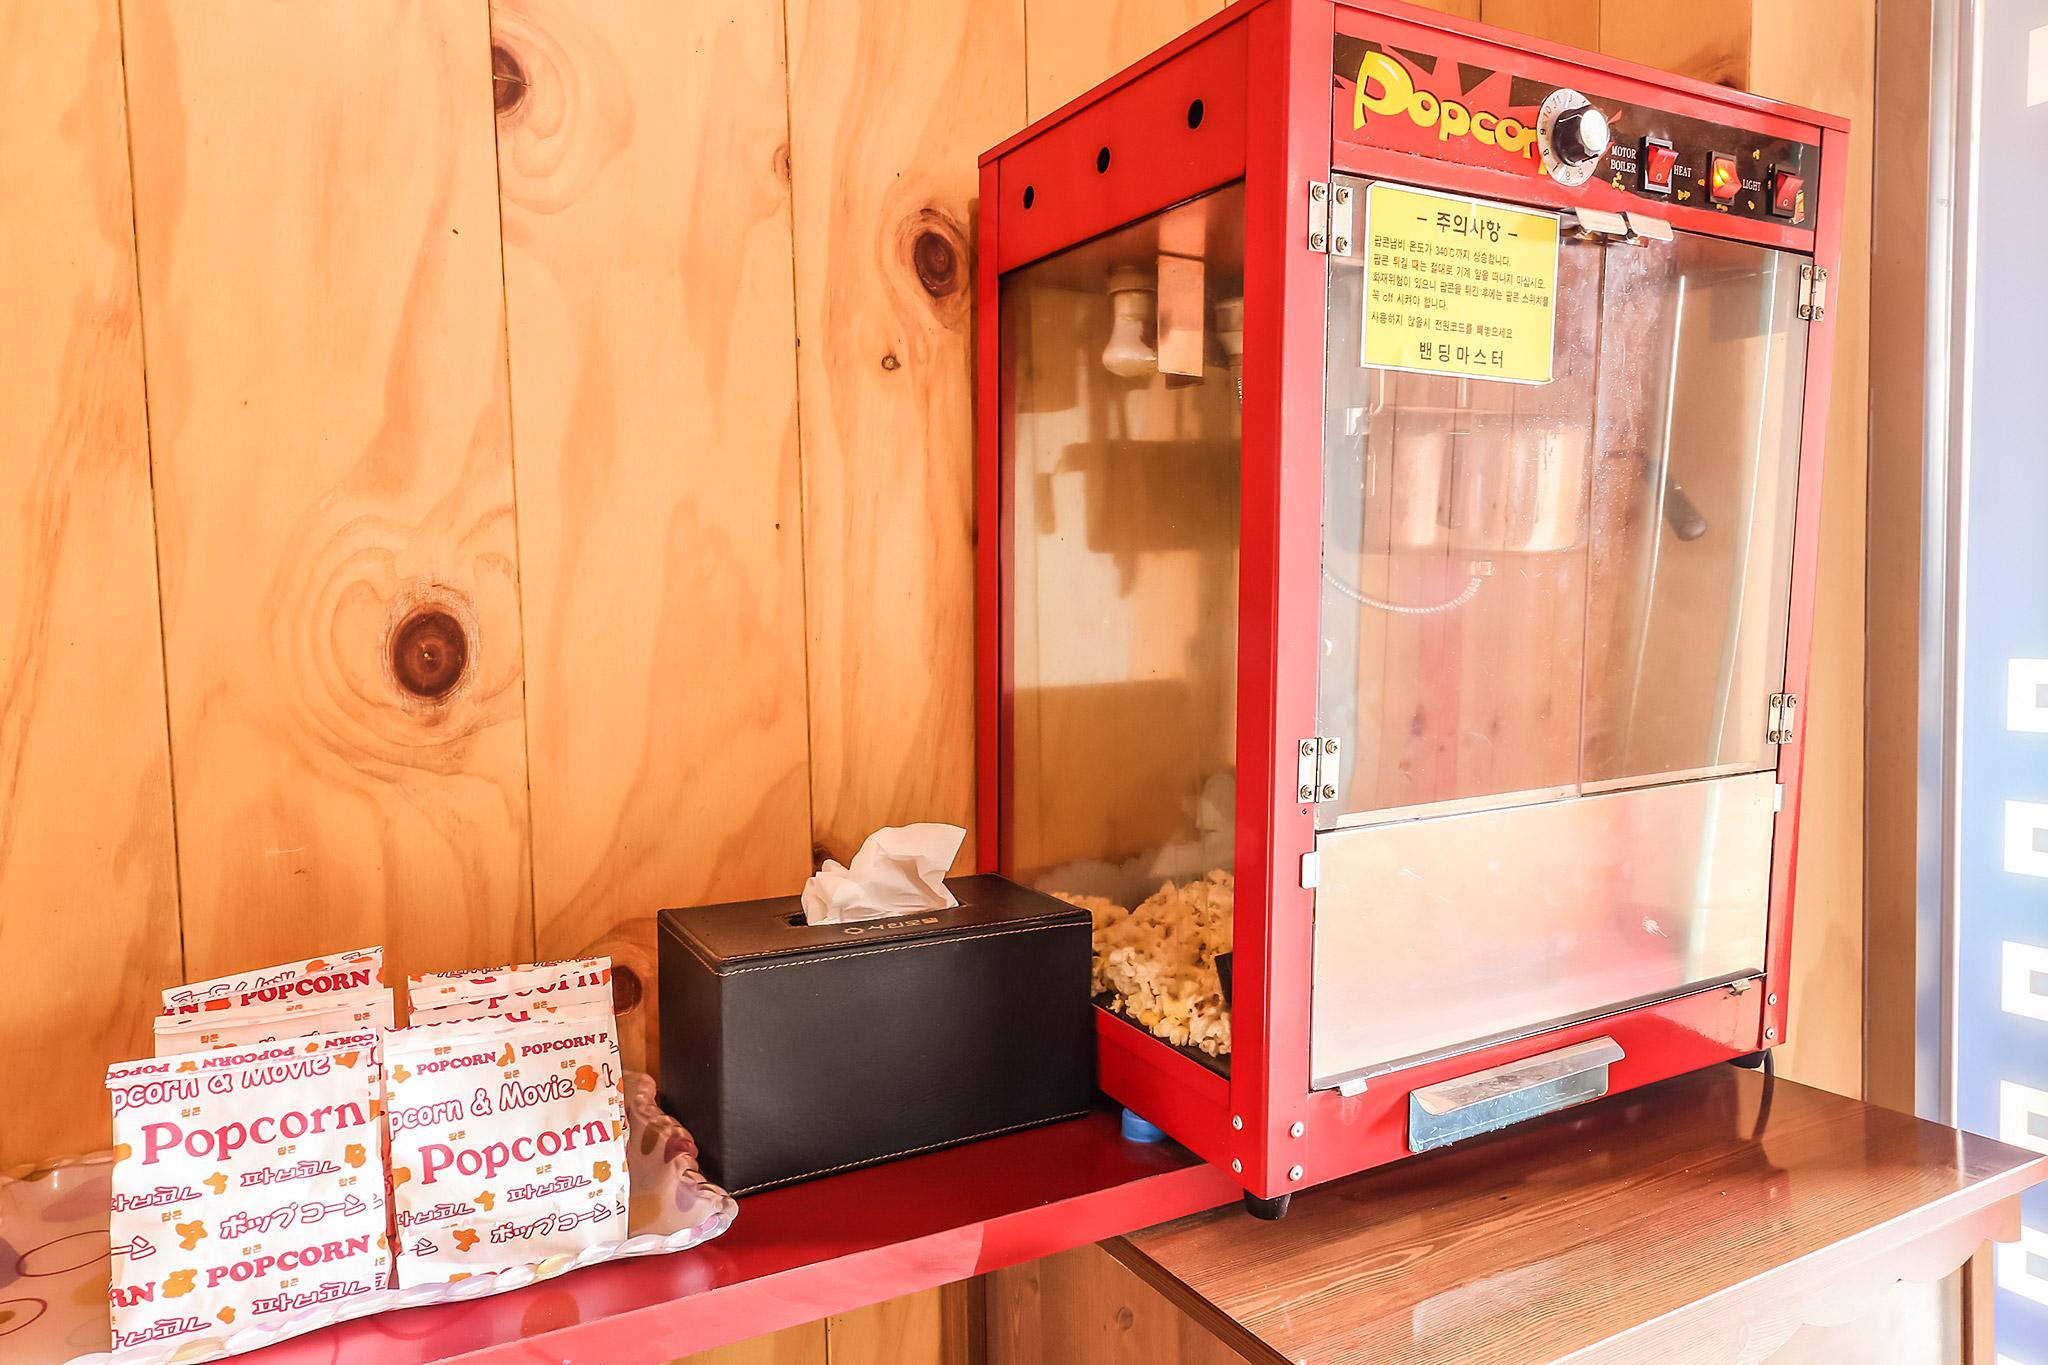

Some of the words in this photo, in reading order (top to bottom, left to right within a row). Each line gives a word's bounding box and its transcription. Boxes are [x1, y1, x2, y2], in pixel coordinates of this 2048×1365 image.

[1354, 50, 1548, 175] Popcor
[1610, 159, 1637, 174] BOILER
[1611, 145, 1637, 160] MOTOR
[1673, 164, 1692, 178] HEAT
[1742, 178, 1762, 192] LIGHT
[1437, 211, 1501, 243] 주의사항
[1374, 234, 1405, 252] 팝콘냄비
[1409, 240, 1432, 256] 온도가
[1473, 251, 1511, 268] 상승합니다.
[1373, 253, 1389, 267] 팝콘
[1393, 256, 1408, 270] 튀길
[1411, 259, 1427, 273] 때는
[1431, 262, 1453, 276] 절대로
[1456, 265, 1471, 279] 기계
[1474, 268, 1489, 282] 앞을
[1492, 271, 1513, 286] 떠나지
[1372, 271, 1411, 288] 화재위험이
[1414, 277, 1436, 292] 있으니
[1440, 281, 1462, 296] 팝콘을
[1465, 284, 1479, 298] 튀긴
[1482, 287, 1503, 301] 후에는
[1506, 290, 1519, 303] 팝콘
[1522, 294, 1549, 308] 스위치를
[1372, 289, 1380, 302] 꼭
[1382, 292, 1394, 303] off
[1396, 293, 1420, 308] 시켜야
[1424, 296, 1449, 310] 합니다.
[1371, 311, 1403, 327] 사용하지
[1408, 315, 1431, 330] 않을시
[1436, 319, 1473, 335] 전원코드를
[240, 969, 371, 1007] POPCORN
[202, 1046, 295, 1068] POPCORN
[417, 1051, 497, 1075] POPCORN
[521, 1034, 596, 1057] POPCORN
[470, 1087, 493, 1117] &
[499, 1074, 576, 1112] Movie
[141, 1101, 366, 1165] Popcorn
[418, 1119, 611, 1185] Popcorn
[219, 1194, 367, 1239] ポップコーン
[490, 1203, 612, 1243] ポップコーン
[206, 1234, 370, 1288] POPCORN
